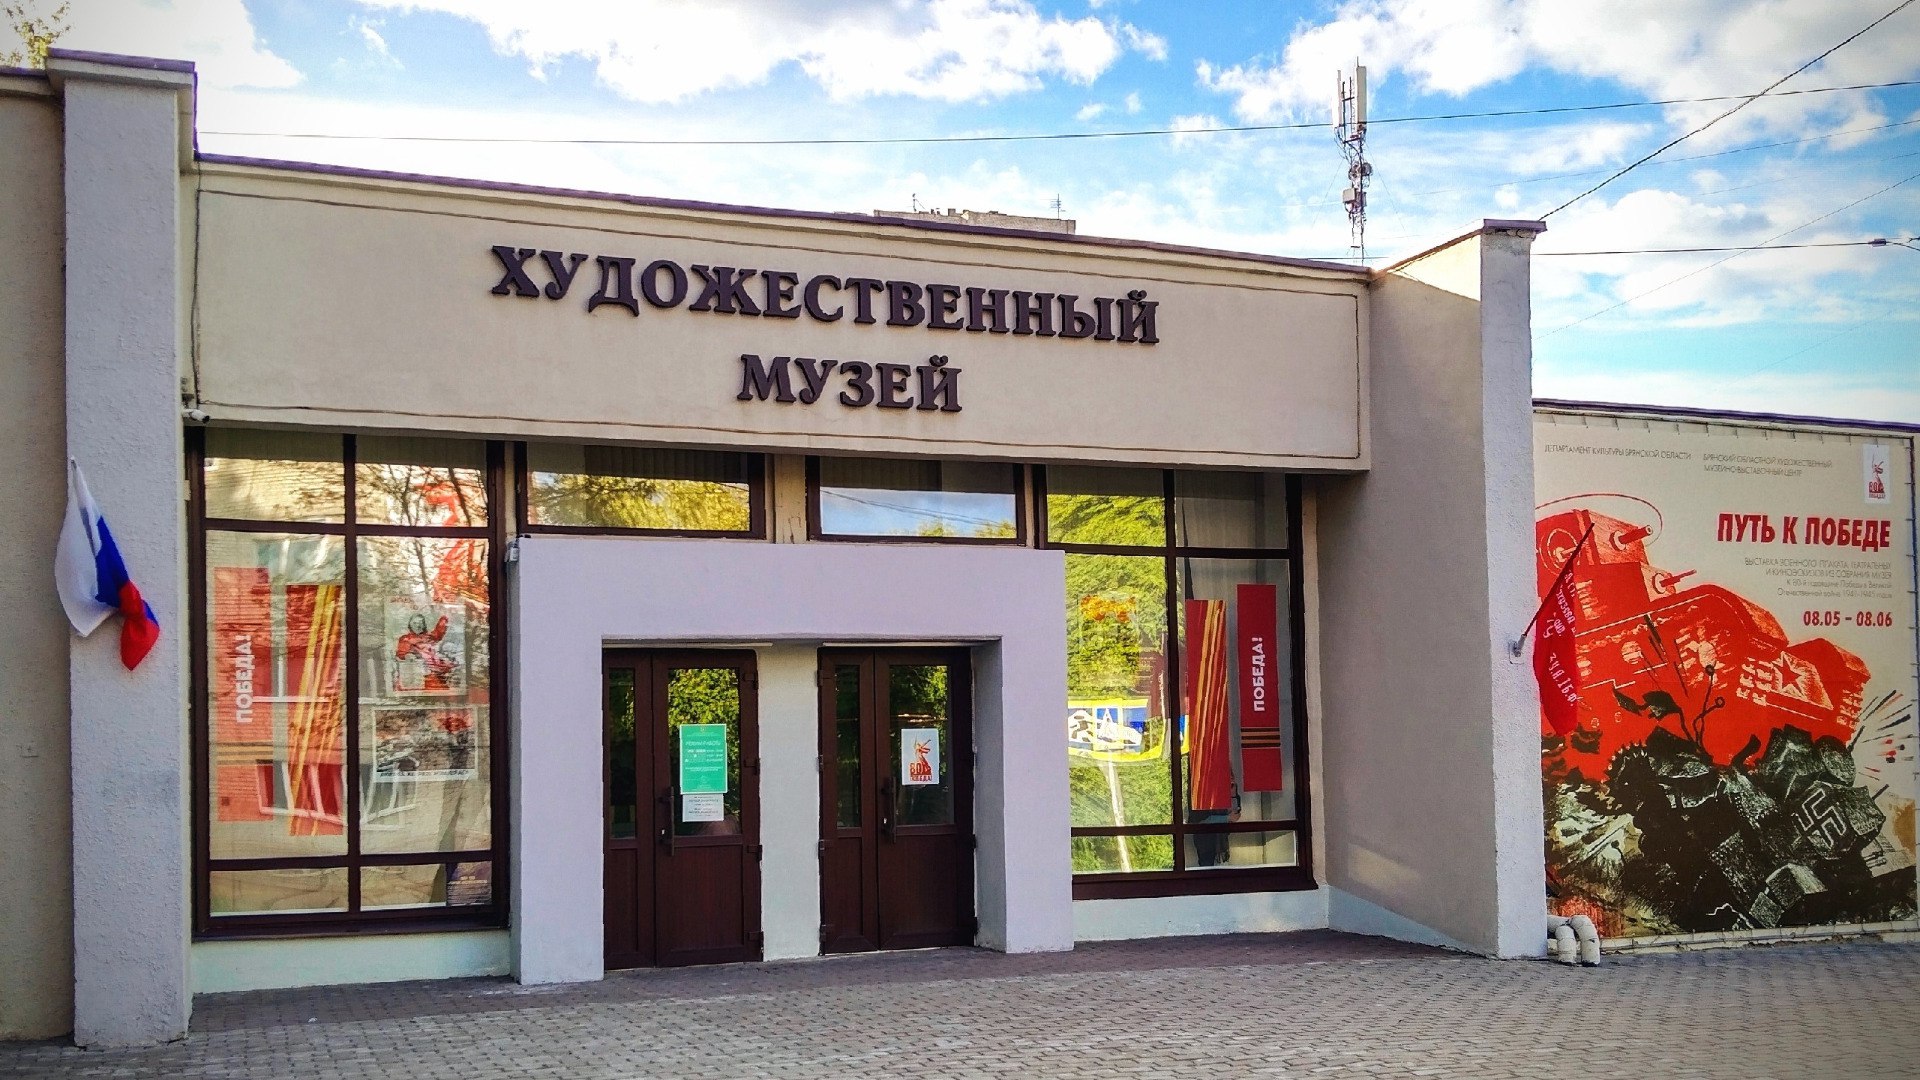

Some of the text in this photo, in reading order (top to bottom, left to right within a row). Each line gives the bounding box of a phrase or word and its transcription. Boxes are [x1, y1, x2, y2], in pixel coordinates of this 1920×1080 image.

[490, 244, 1161, 344] ХУДОЖЕСТВЕННЫЙ
[737, 353, 962, 412] МУЗЕЙ
[1660, 450, 1692, 460] ОБЛАСТИ
[1717, 513, 1891, 552] ПУТЬ К ПОБЕДЕ
[1744, 557, 1778, 566] ВЫСТАВКА
[1803, 610, 1840, 627] 08.05
[1856, 610, 1893, 627] 08.06
[235, 634, 255, 723] ПОБЕДА!
[1251, 637, 1266, 712] ПОБЕДА!
